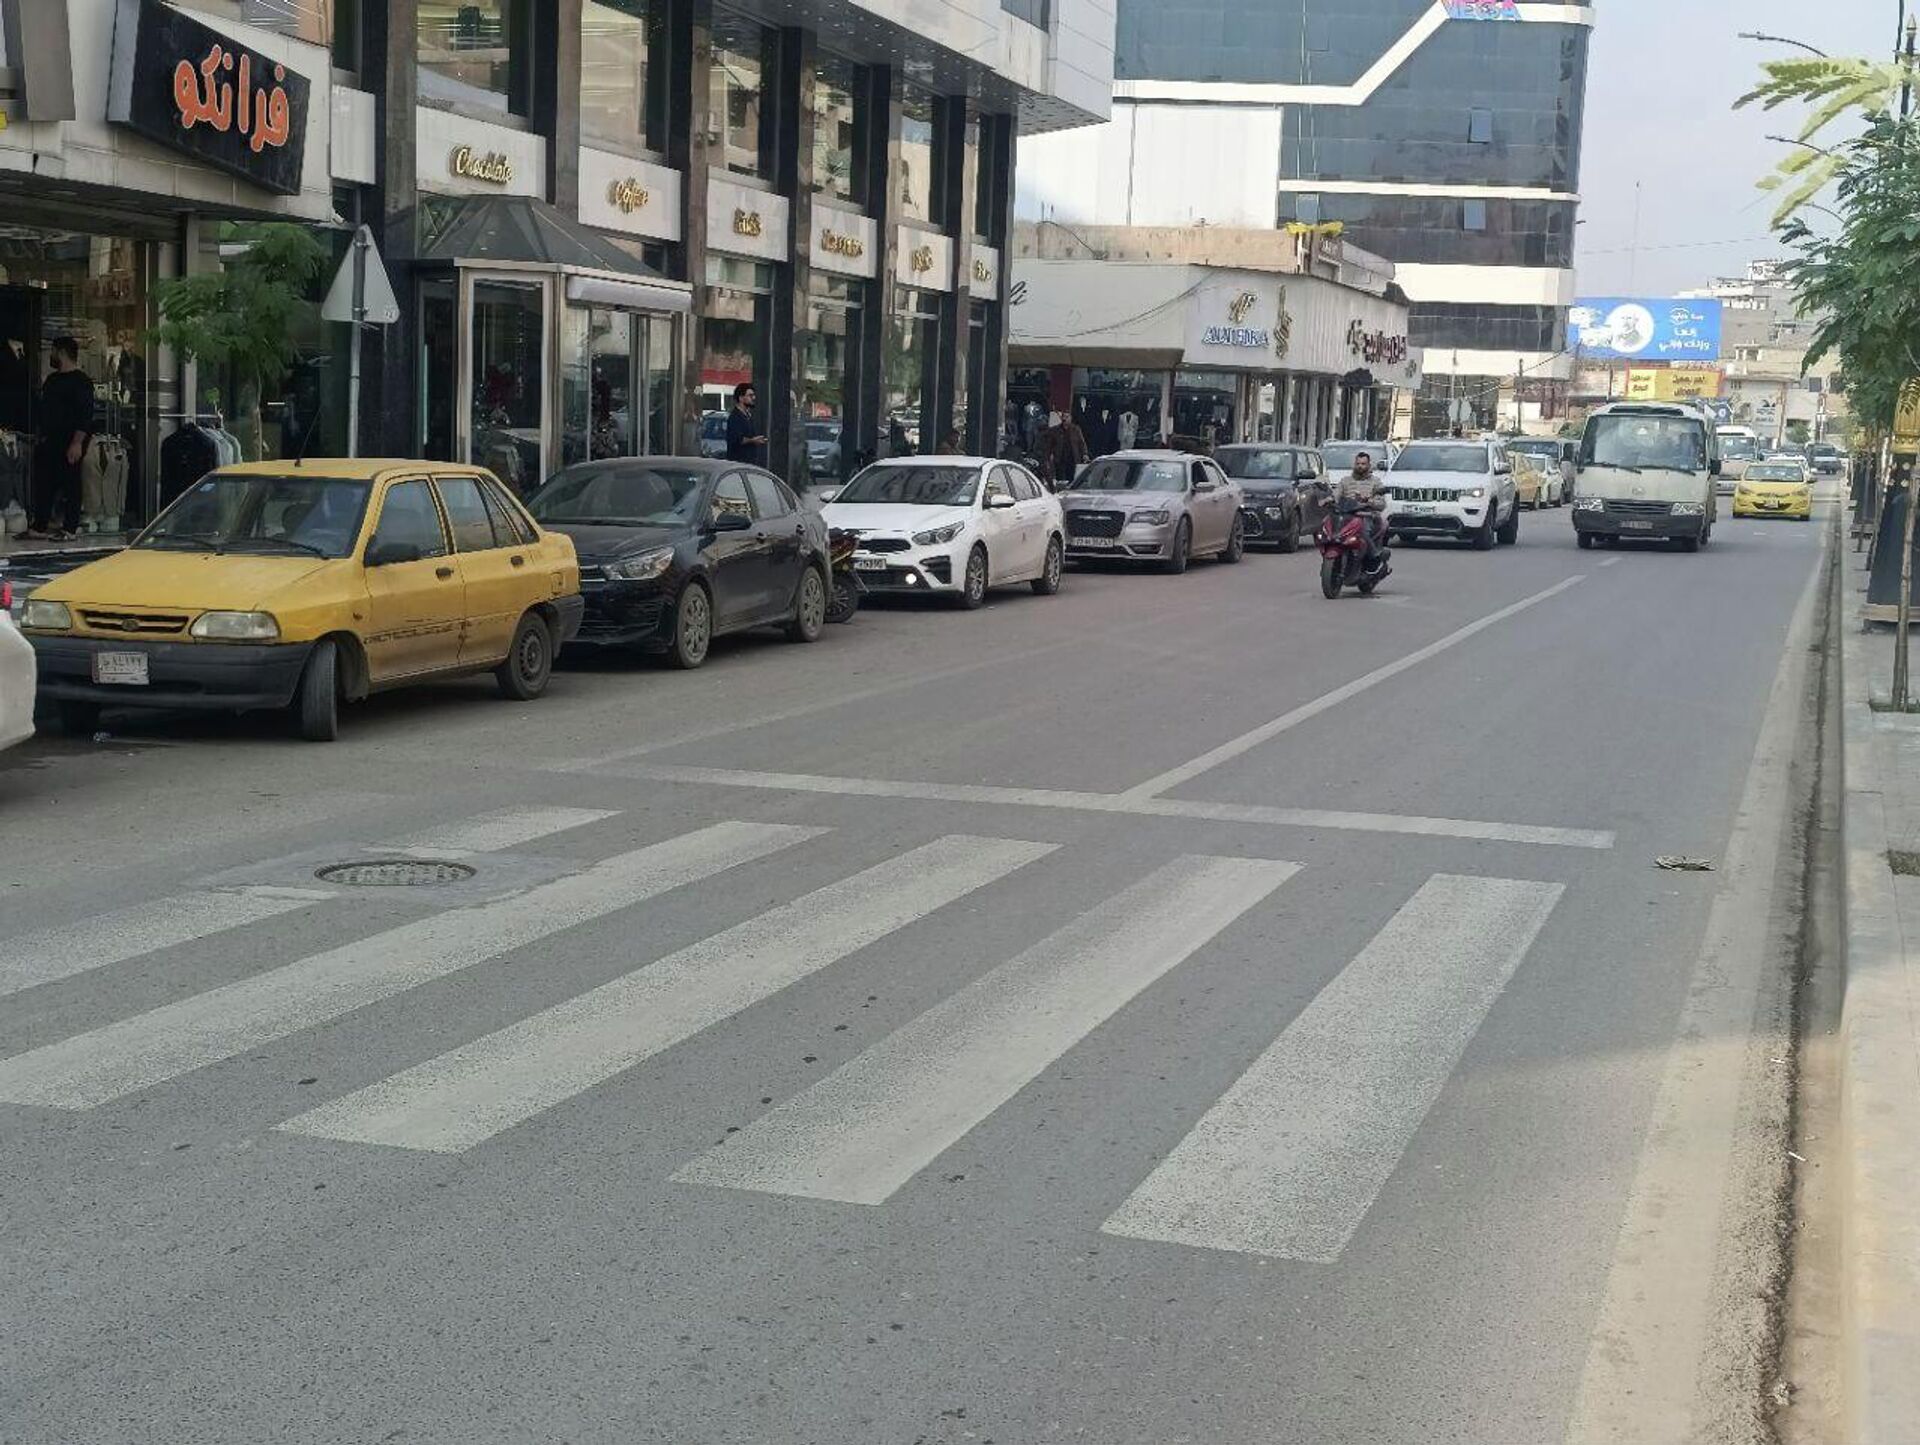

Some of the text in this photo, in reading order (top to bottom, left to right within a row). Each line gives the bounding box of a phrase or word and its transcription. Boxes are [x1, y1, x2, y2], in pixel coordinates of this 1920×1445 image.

[174, 44, 290, 152] فرانكو
[454, 146, 513, 186] Chocolate
[614, 178, 650, 214] Coffee
